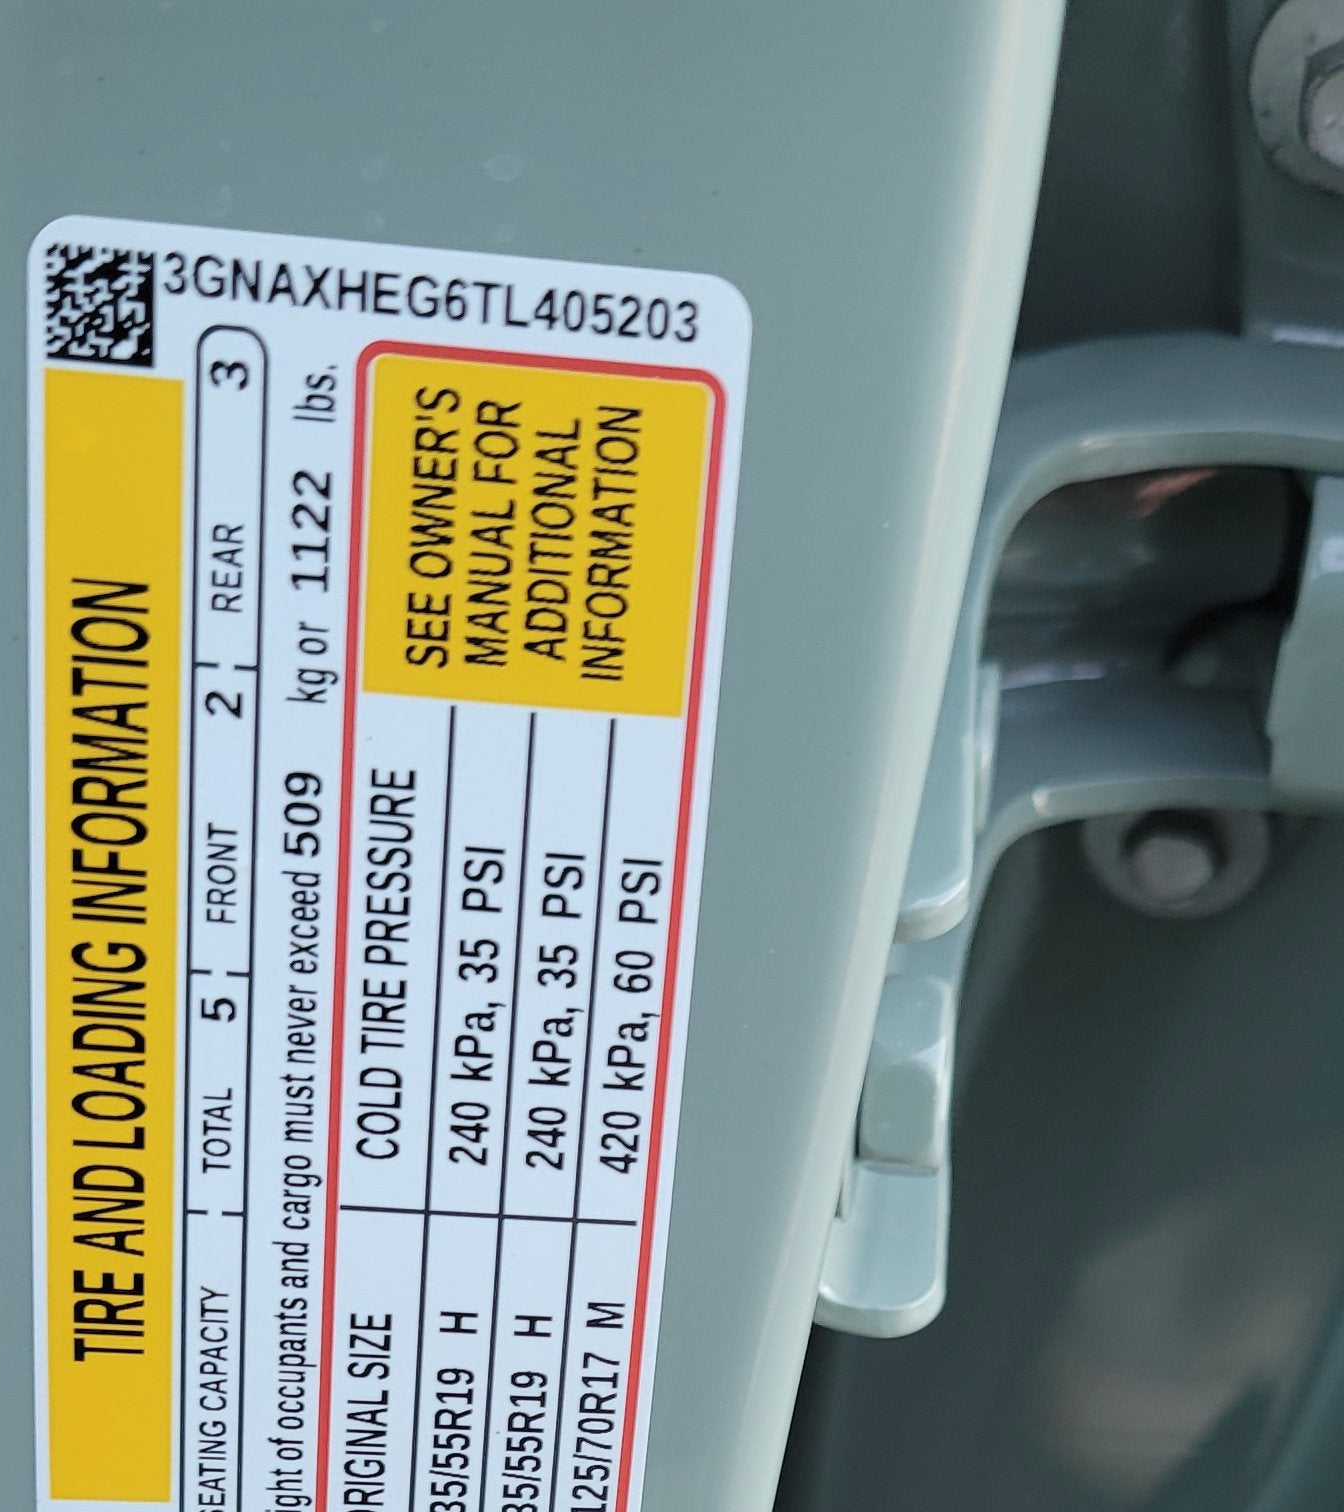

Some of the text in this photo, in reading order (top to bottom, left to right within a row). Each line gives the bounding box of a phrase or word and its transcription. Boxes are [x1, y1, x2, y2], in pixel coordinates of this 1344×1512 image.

[163, 251, 697, 343] 3GNAXHEG6TL405203
[293, 365, 336, 423] lbs.
[209, 360, 249, 613] REAR 3
[290, 470, 331, 592] 1122
[405, 388, 460, 669] SEE OWNER'S
[464, 400, 520, 666] MANUAL FOR
[523, 420, 580, 661] ADDITIONAL
[581, 406, 641, 681] INFORMATION
[286, 668, 339, 704] kg
[298, 621, 328, 656] or
[204, 690, 243, 924] FRONT 2
[283, 771, 322, 858] 509
[70, 578, 150, 1362] TIRE AND LOADING INFORMATION
[281, 870, 321, 975] exceed
[355, 768, 416, 1160] COLD TIRE PRESSURE
[286, 984, 317, 1064] never
[448, 846, 506, 1166] 240 kPa, 35 PSI
[525, 852, 586, 1171] 240 kPa, 35 PSI
[599, 858, 663, 1175] 420 kPa, 60 PSI
[200, 997, 237, 1174] TOTAL 5
[280, 1073, 315, 1143] must
[282, 1154, 323, 1231] cargo
[280, 1241, 310, 1289] and
[585, 1301, 626, 1329] M
[199, 1286, 229, 1411] CAPACITY
[275, 1297, 317, 1430] occupants
[347, 1313, 393, 1381] SIZE
[439, 1310, 479, 1335] H
[513, 1314, 553, 1338] H
[267, 1437, 304, 1461] of
